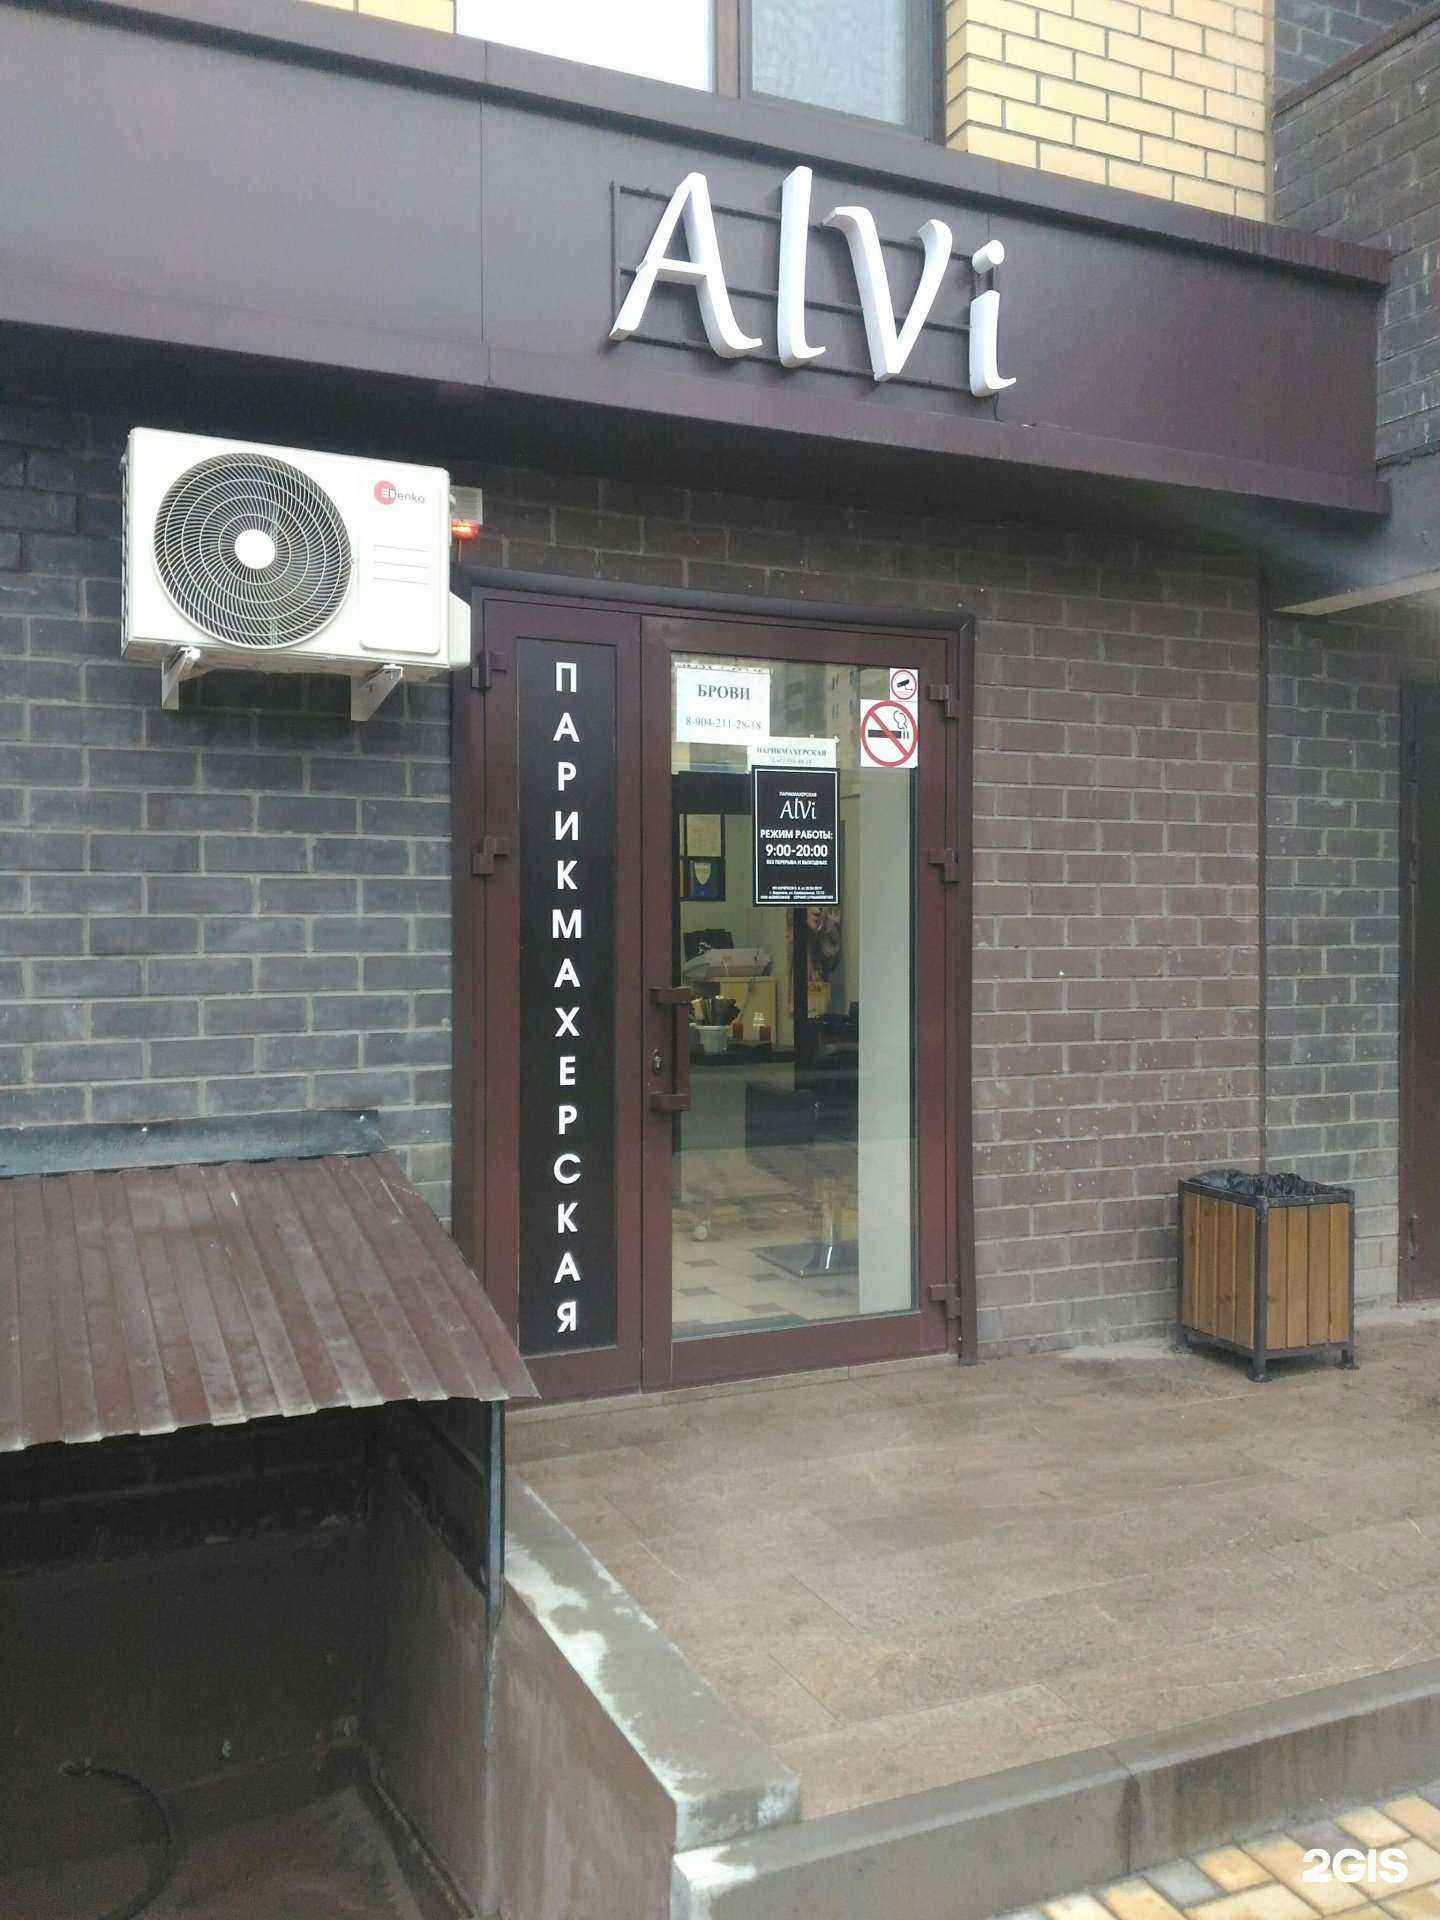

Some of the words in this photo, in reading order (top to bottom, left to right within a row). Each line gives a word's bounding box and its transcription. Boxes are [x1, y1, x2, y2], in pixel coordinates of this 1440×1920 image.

[697, 684, 751, 701] БРОВИ
[760, 829, 793, 839] РЕЖИМ
[795, 830, 834, 840] РАБОТЫ:
[765, 844, 828, 857] 9:00-20:00
[552, 661, 583, 1334] ПАРИКМАХЕРСКАЯ
